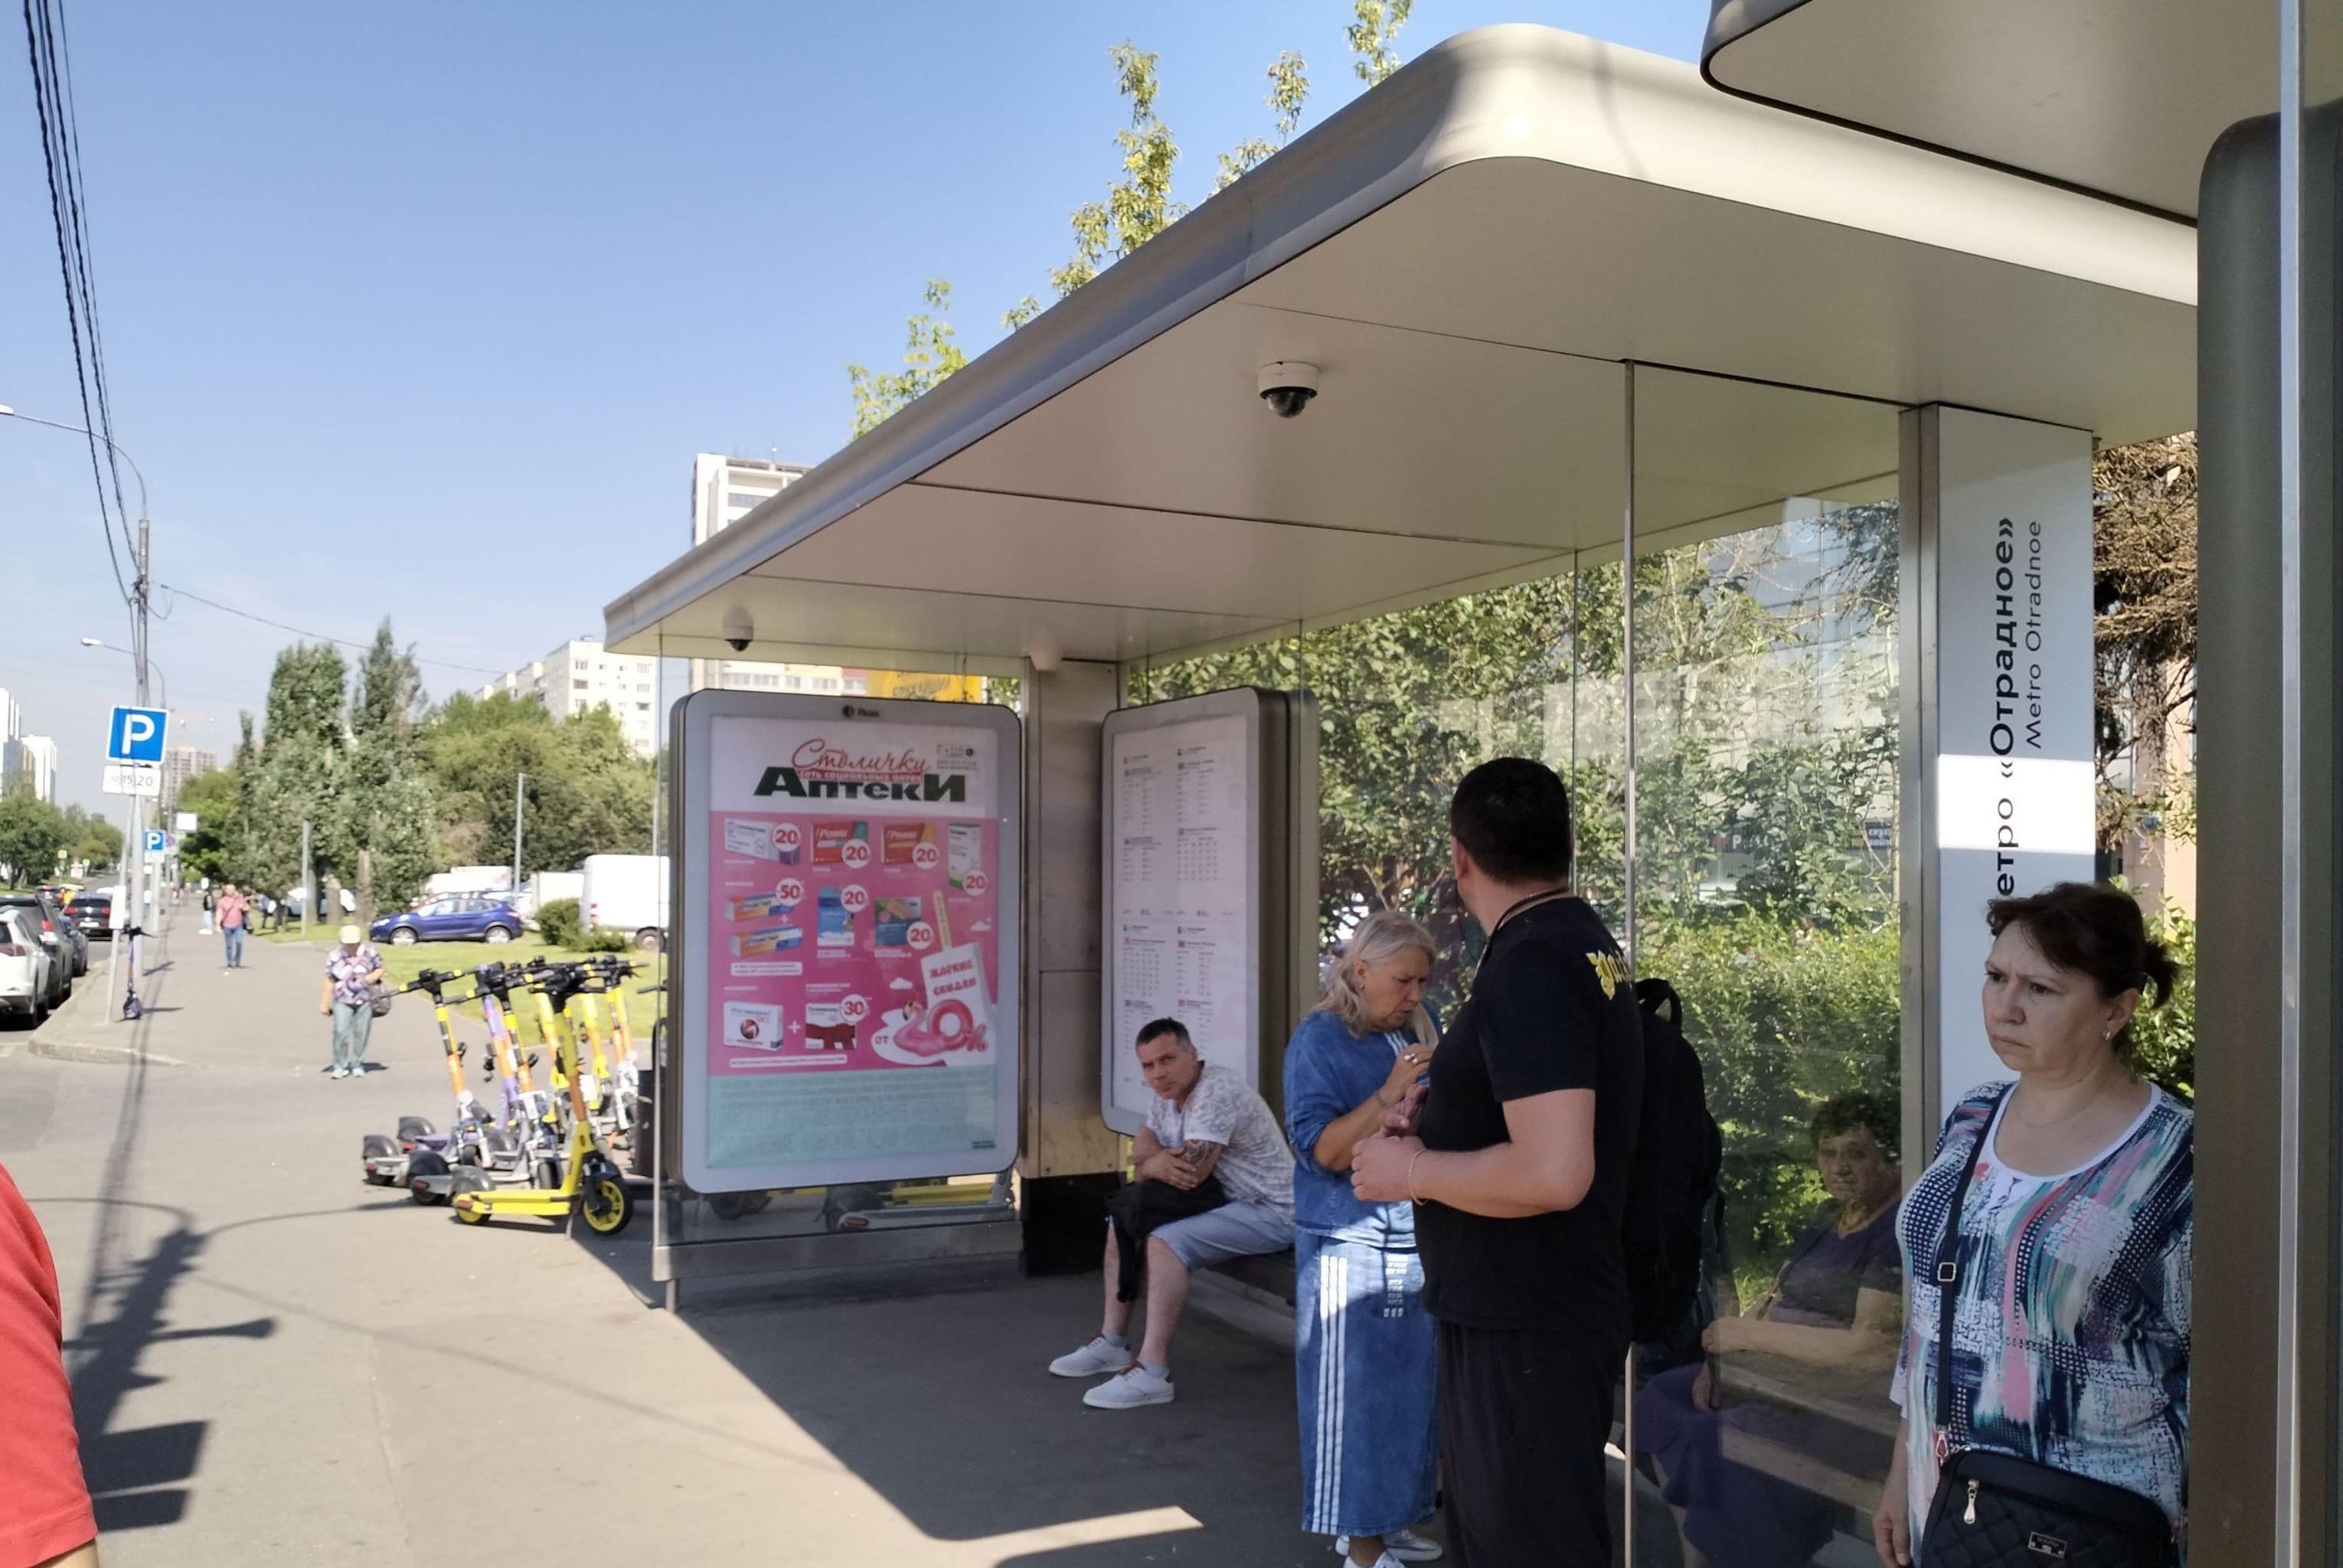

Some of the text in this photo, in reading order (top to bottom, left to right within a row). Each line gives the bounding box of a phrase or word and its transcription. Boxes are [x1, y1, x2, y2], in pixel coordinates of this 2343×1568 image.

[2024, 520, 2041, 750] Metro Otradnoe
[1990, 517, 2018, 896] етро «Отрадное»
[121, 714, 155, 754] P
[147, 832, 161, 850] P
[933, 976, 977, 996] СКИДКИ
